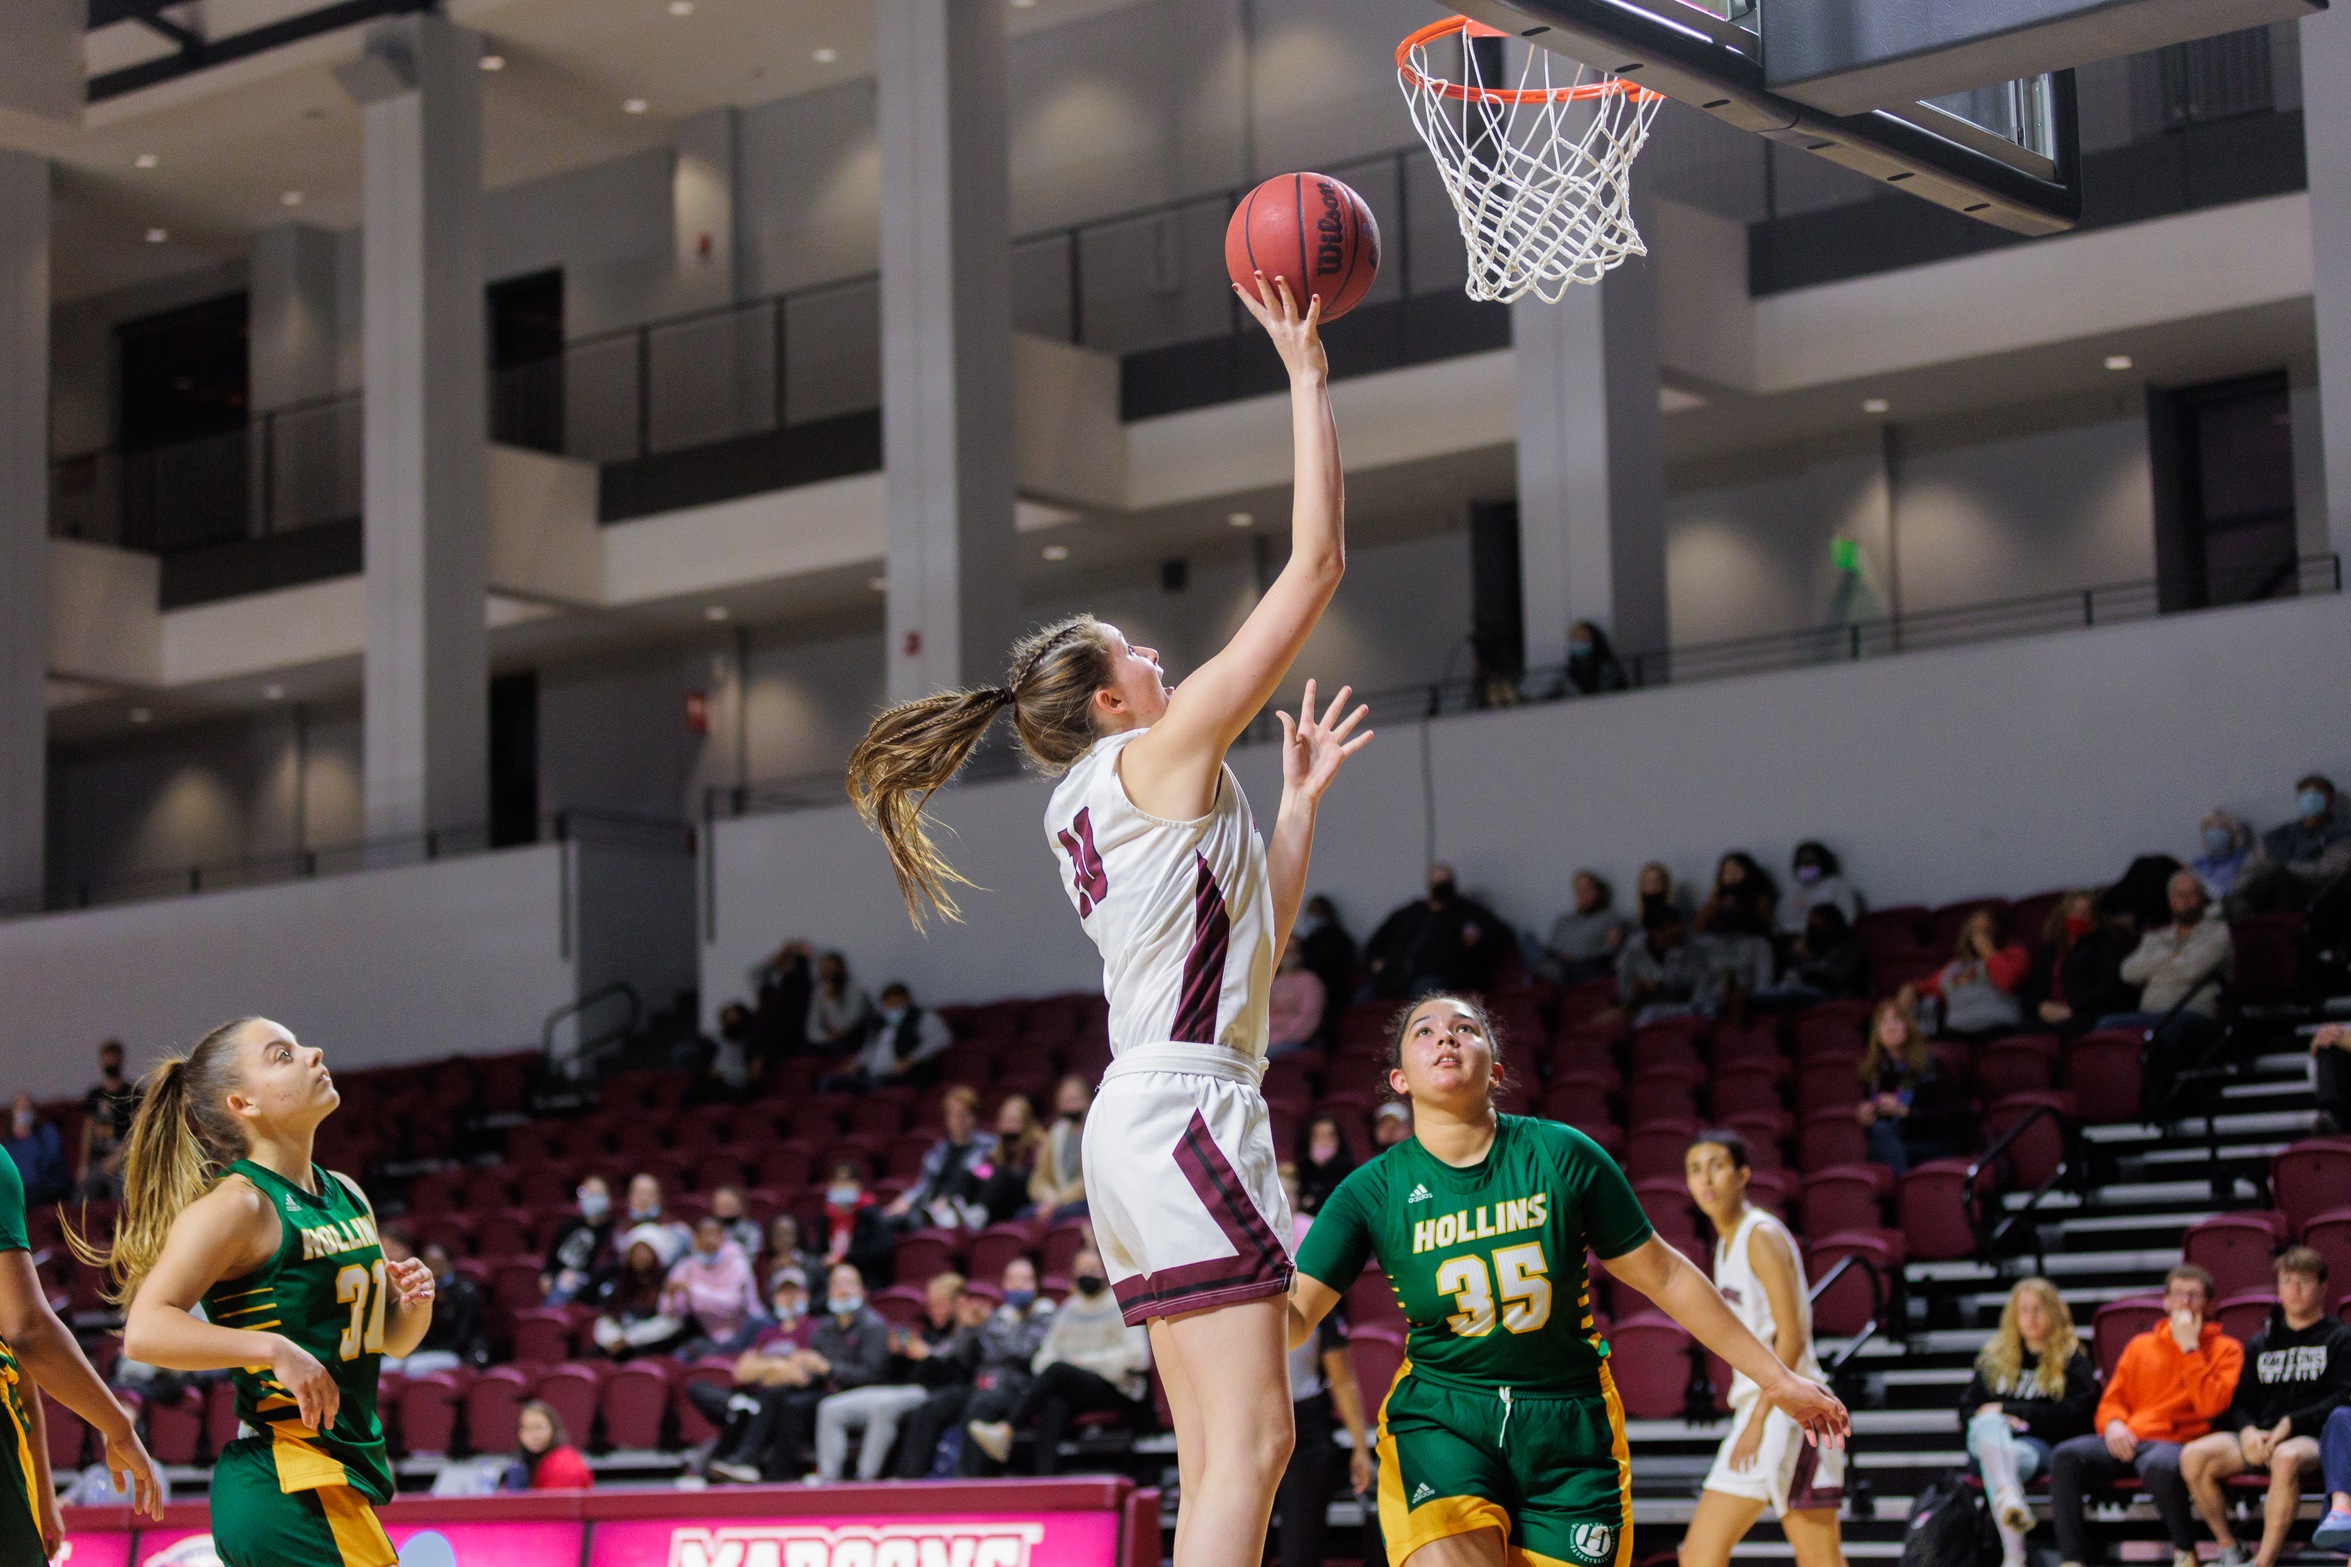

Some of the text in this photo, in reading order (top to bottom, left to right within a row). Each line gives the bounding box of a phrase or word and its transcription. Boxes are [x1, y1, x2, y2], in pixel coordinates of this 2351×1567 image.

[1317, 182, 1343, 277] Wilson
[301, 1215, 379, 1260] HOLLIN
[1412, 1192, 1548, 1254] HOLLINS
[1435, 1241, 1553, 1338] 35
